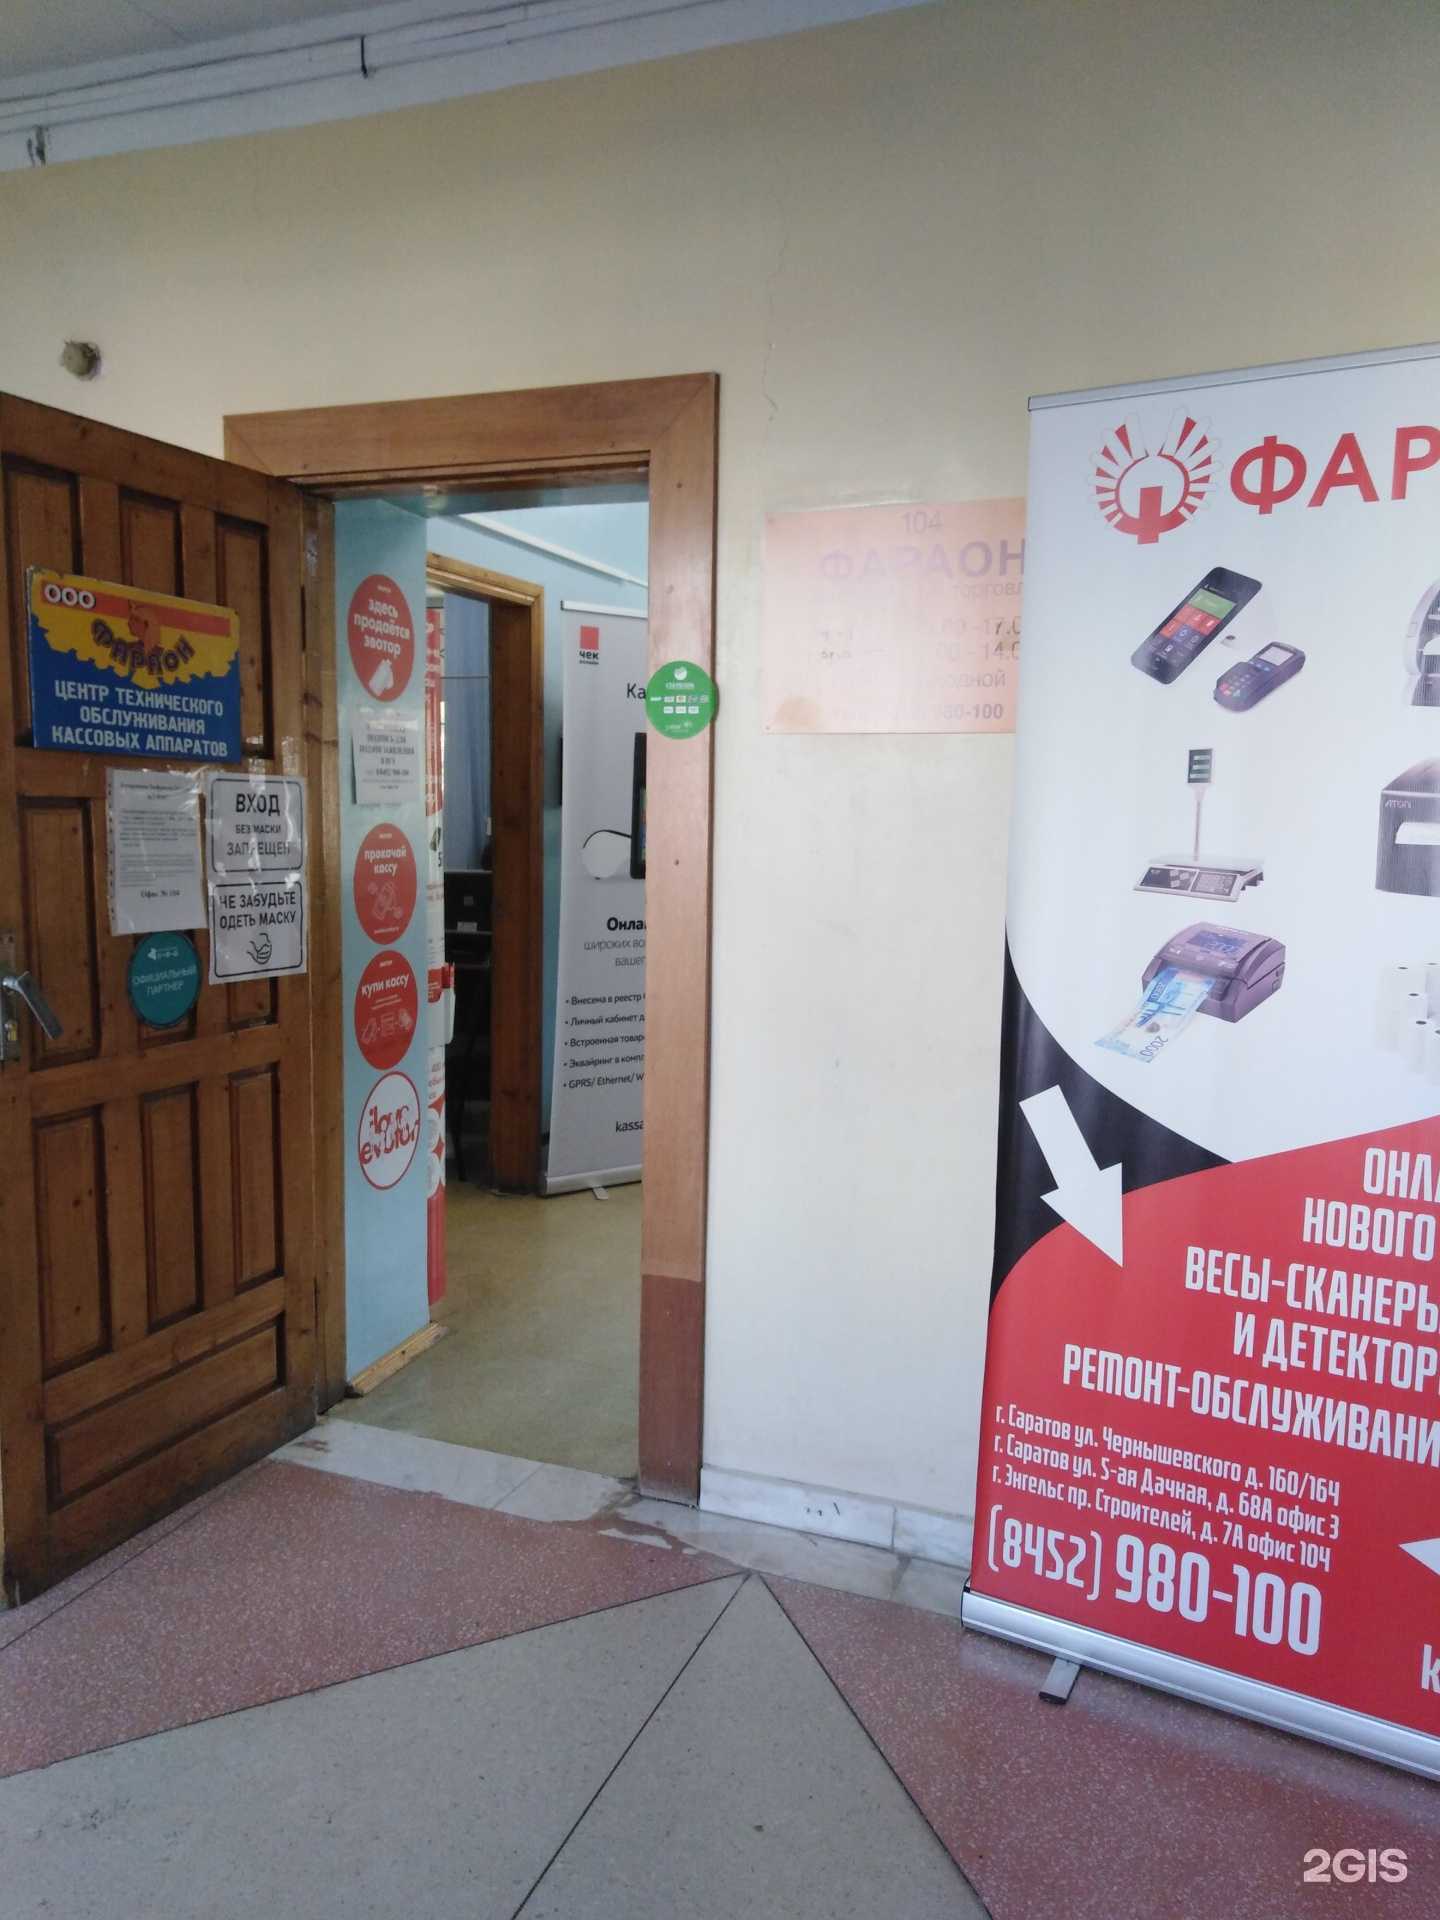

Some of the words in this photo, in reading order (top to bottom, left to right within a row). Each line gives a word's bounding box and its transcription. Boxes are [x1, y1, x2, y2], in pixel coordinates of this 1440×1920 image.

[1230, 425, 1440, 515] ФАР
[904, 510, 944, 534] 104
[820, 538, 1026, 579] ФАРАОН
[44, 583, 96, 609] ООО
[368, 598, 398, 618] здесь
[54, 680, 109, 702] ЦЕНТР
[115, 687, 223, 716] ТЕХНИЧЕСКОГО
[80, 706, 205, 735] ОБСЛУЖИВАНИЯ
[52, 726, 140, 750] КАССОВЫХ
[146, 734, 228, 757] АППАРАТОВ
[236, 793, 280, 816] ВХОД
[254, 824, 281, 834] МАСКИ
[240, 891, 296, 907] ЗАБУДЬТЕ
[220, 913, 256, 930] ОДЕТЬ
[260, 911, 296, 926] МАСКУ
[361, 981, 385, 998] купи
[1302, 1196, 1437, 1263] НОВОГО
[1233, 1311, 1256, 1358] И
[1262, 1317, 1440, 1395] ДЕТЕКТОР
[996, 1405, 1005, 1424] г.
[1008, 1404, 1071, 1441] Саратов
[1074, 1425, 1098, 1448] ул.
[1102, 1426, 1242, 1483] Чернышевского
[1244, 1467, 1264, 1491] д.
[1269, 1466, 1340, 1507] 160/164
[994, 1434, 1003, 1453] г.
[1006, 1433, 1069, 1471] Саратов
[1072, 1455, 1097, 1478] ул.
[1100, 1457, 1137, 1488] 5-ая
[1140, 1467, 1213, 1512] Дачная,
[1216, 1492, 1234, 1516] д.
[1239, 1491, 1273, 1523] 68А
[1277, 1505, 1326, 1537] офис
[1329, 1513, 1340, 1540] 3
[992, 1465, 1002, 1484] г.
[1005, 1464, 1065, 1501] Энгельс
[1067, 1485, 1092, 1511] пр.
[1095, 1488, 1197, 1541] Строителей,
[1200, 1521, 1218, 1545] д.
[1222, 1520, 1244, 1549] 7А
[1247, 1531, 1296, 1563] офис
[1299, 1540, 1331, 1573] 104
[987, 1503, 1102, 1601] (8452)
[1115, 1533, 1323, 1657] 980-100
